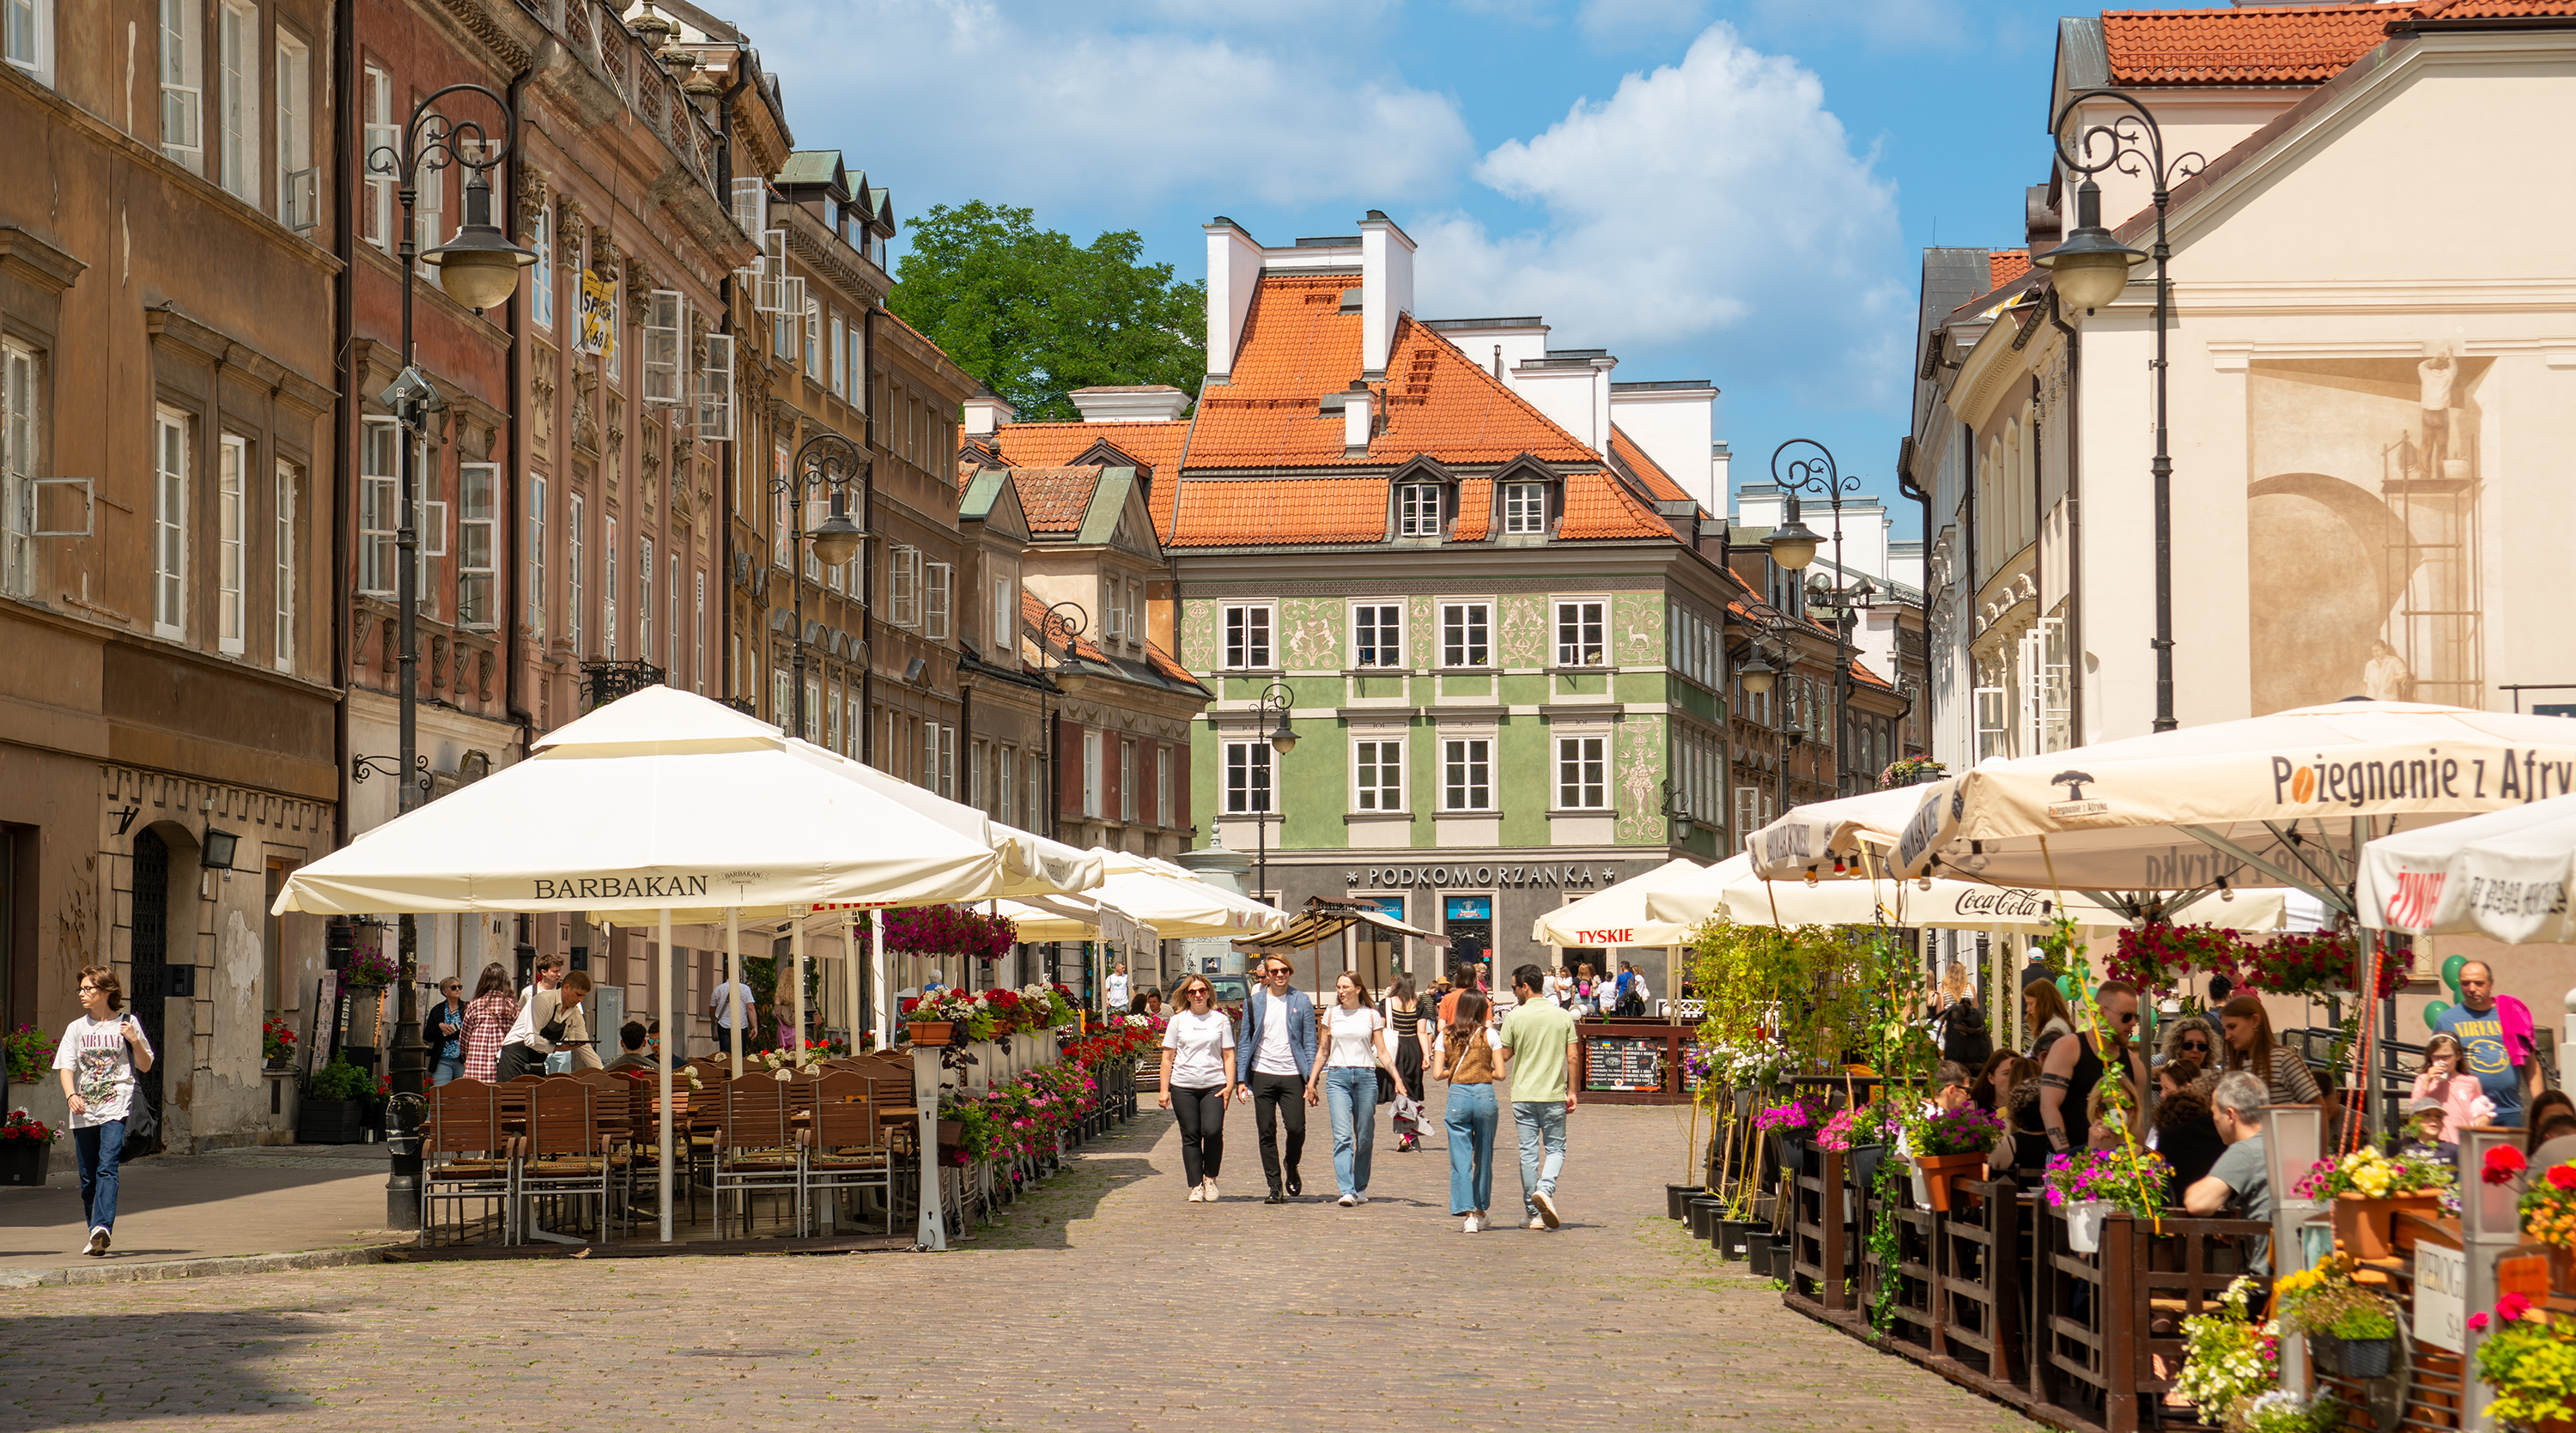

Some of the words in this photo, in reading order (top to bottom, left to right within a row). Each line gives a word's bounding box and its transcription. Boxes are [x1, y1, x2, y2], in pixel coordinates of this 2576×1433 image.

[2270, 748, 2459, 808] Pożegnanie
[2471, 759, 2486, 798] z
[724, 871, 762, 879] BARBAKAN
[1369, 865, 1594, 885] PODKOMORZANKA
[533, 875, 708, 900] BARBAKAN
[1955, 888, 2042, 916] Coca-Cola
[1575, 928, 1634, 944] TYSKIE
